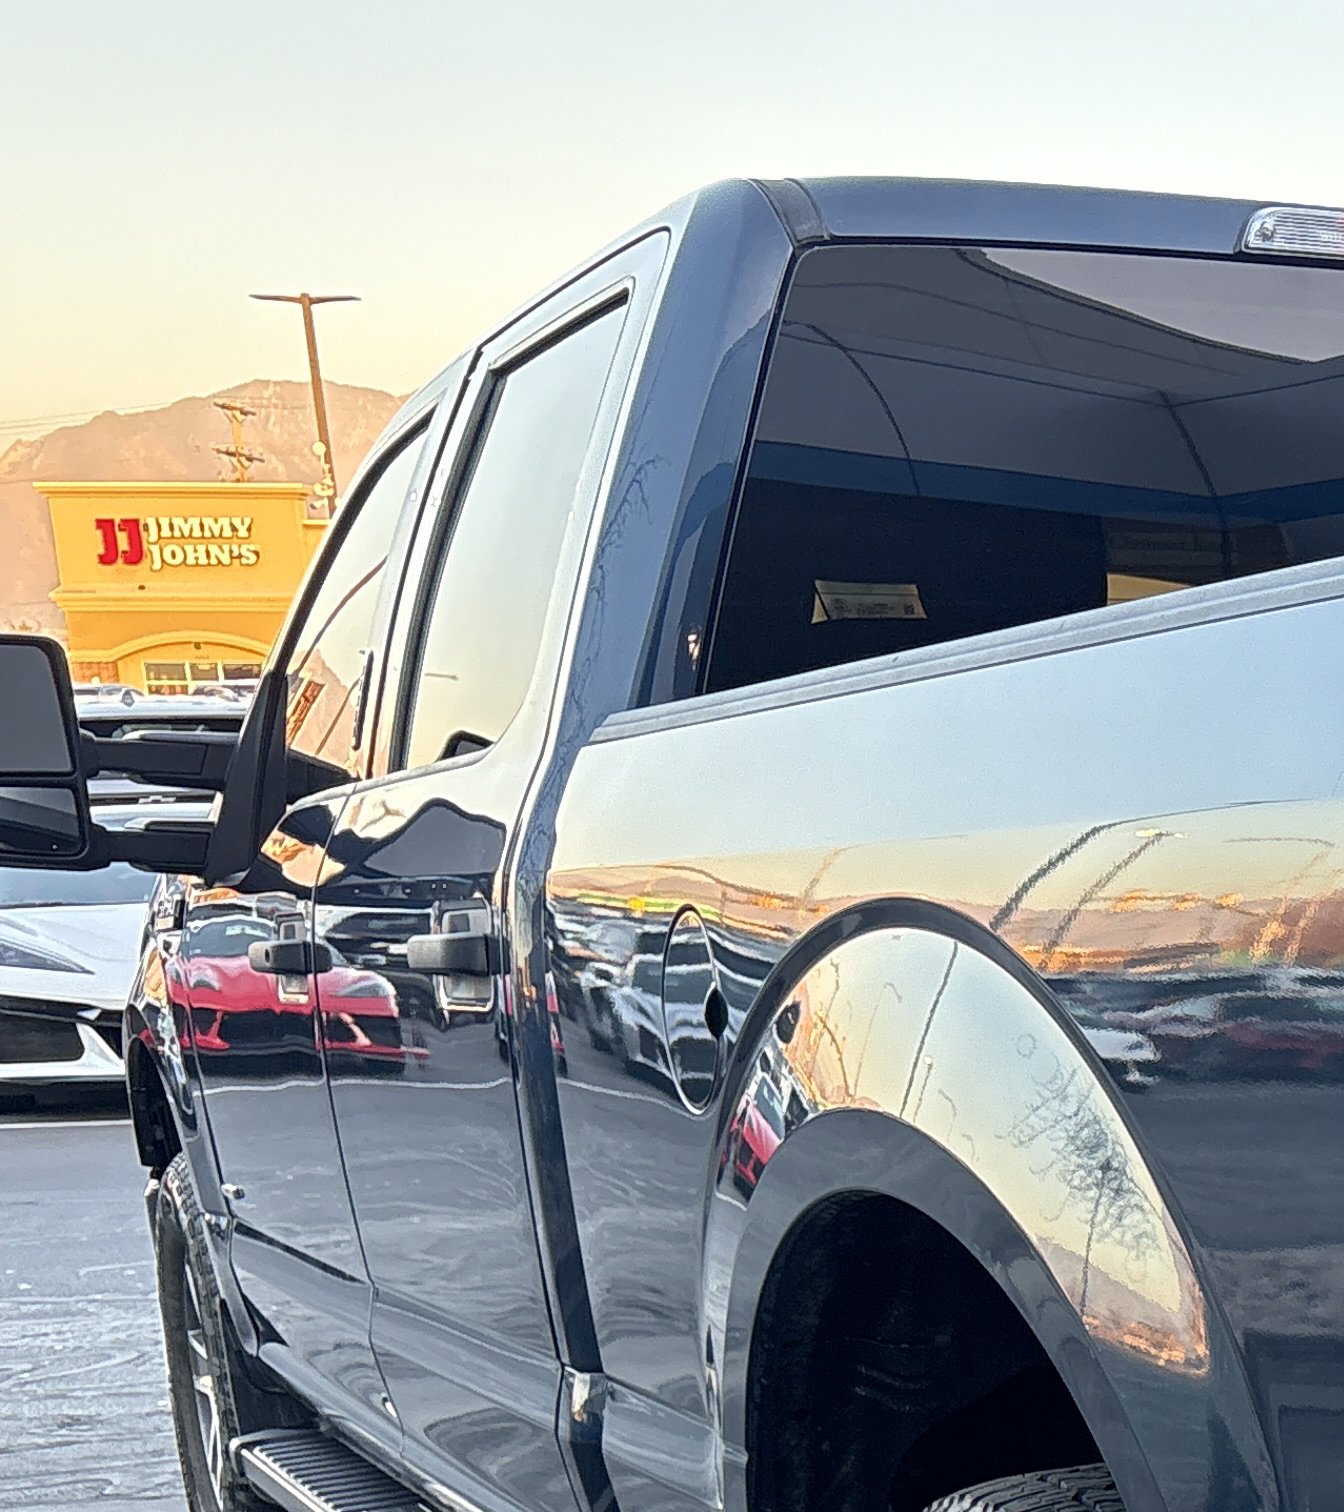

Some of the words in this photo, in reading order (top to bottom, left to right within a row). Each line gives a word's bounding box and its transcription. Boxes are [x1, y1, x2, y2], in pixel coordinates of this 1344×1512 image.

[95, 518, 144, 565] JJ
[146, 516, 252, 543] JIMMY
[149, 543, 259, 570] JOHN'S
